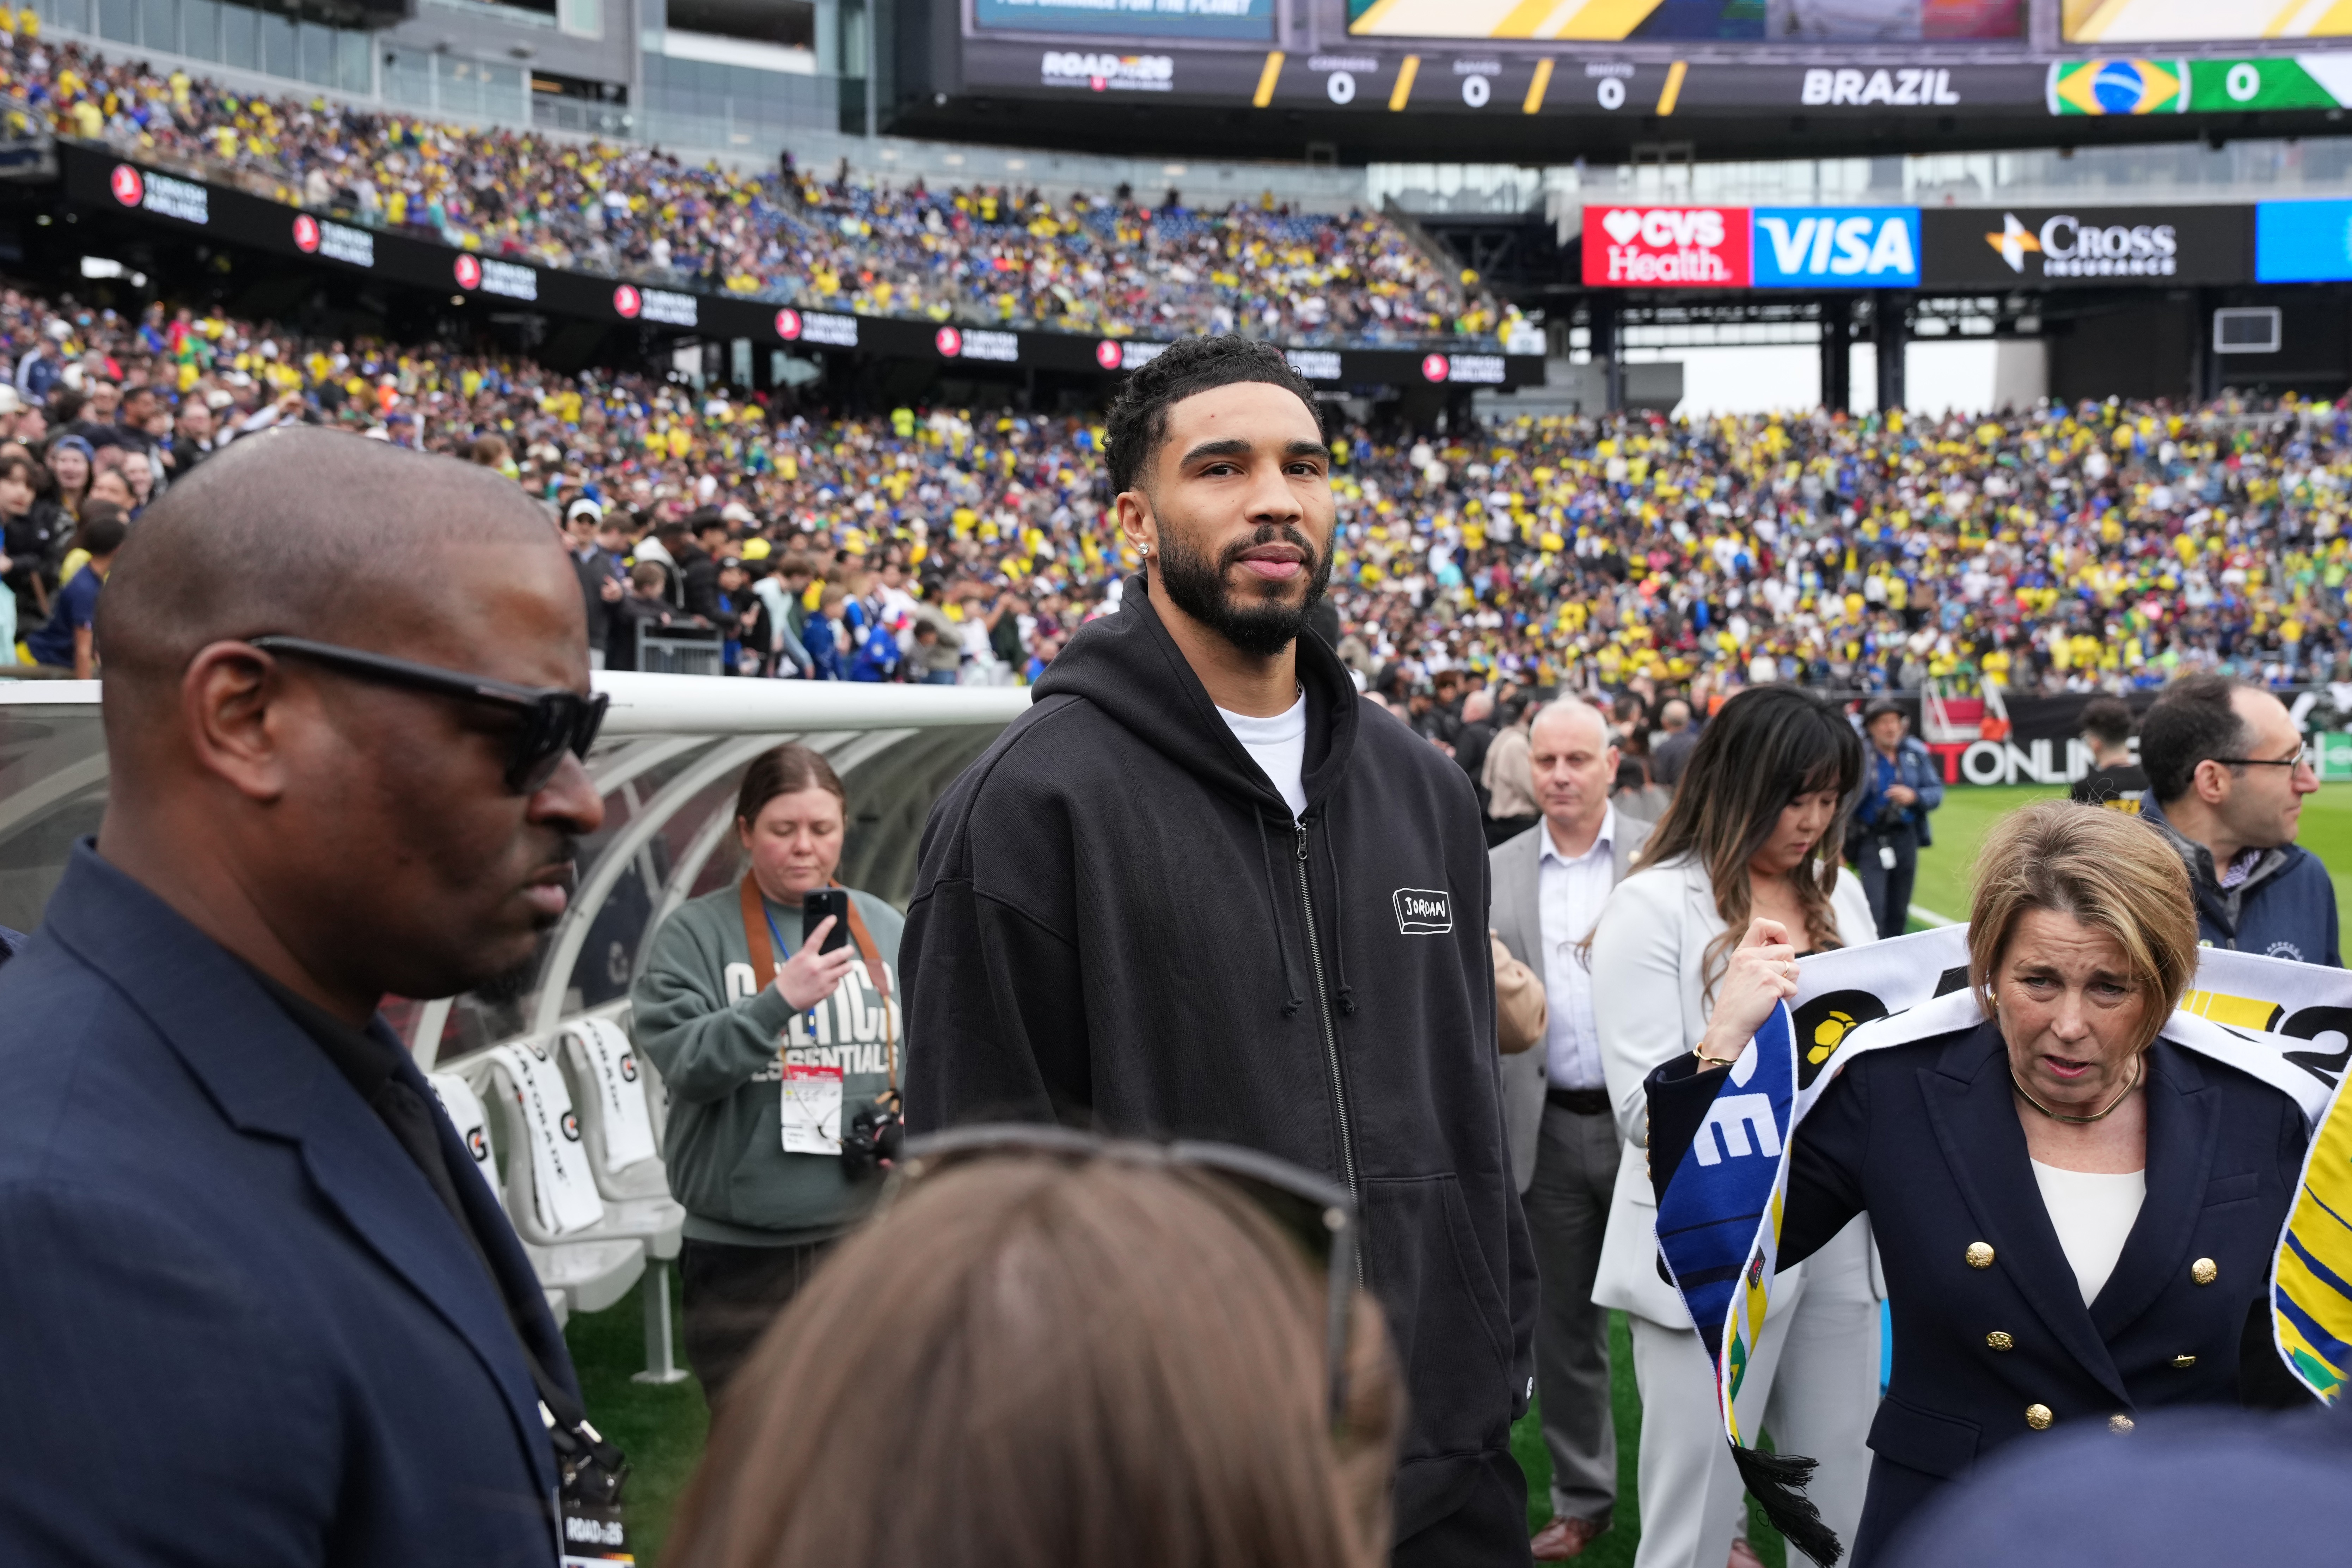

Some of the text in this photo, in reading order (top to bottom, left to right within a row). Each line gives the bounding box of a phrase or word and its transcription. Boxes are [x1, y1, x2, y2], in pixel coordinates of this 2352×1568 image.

[1327, 71, 1356, 104] 0
[1462, 74, 1490, 107] 0
[1597, 77, 1626, 110] 0
[1801, 69, 1960, 106] BRAZIL
[2225, 63, 2260, 101] 0
[1641, 210, 1725, 247] CVS
[1756, 217, 1915, 275] VISA
[1606, 245, 1725, 282] Health
[2043, 258, 2176, 276] INSURANCE
[1405, 897, 1446, 917] JORDAN
